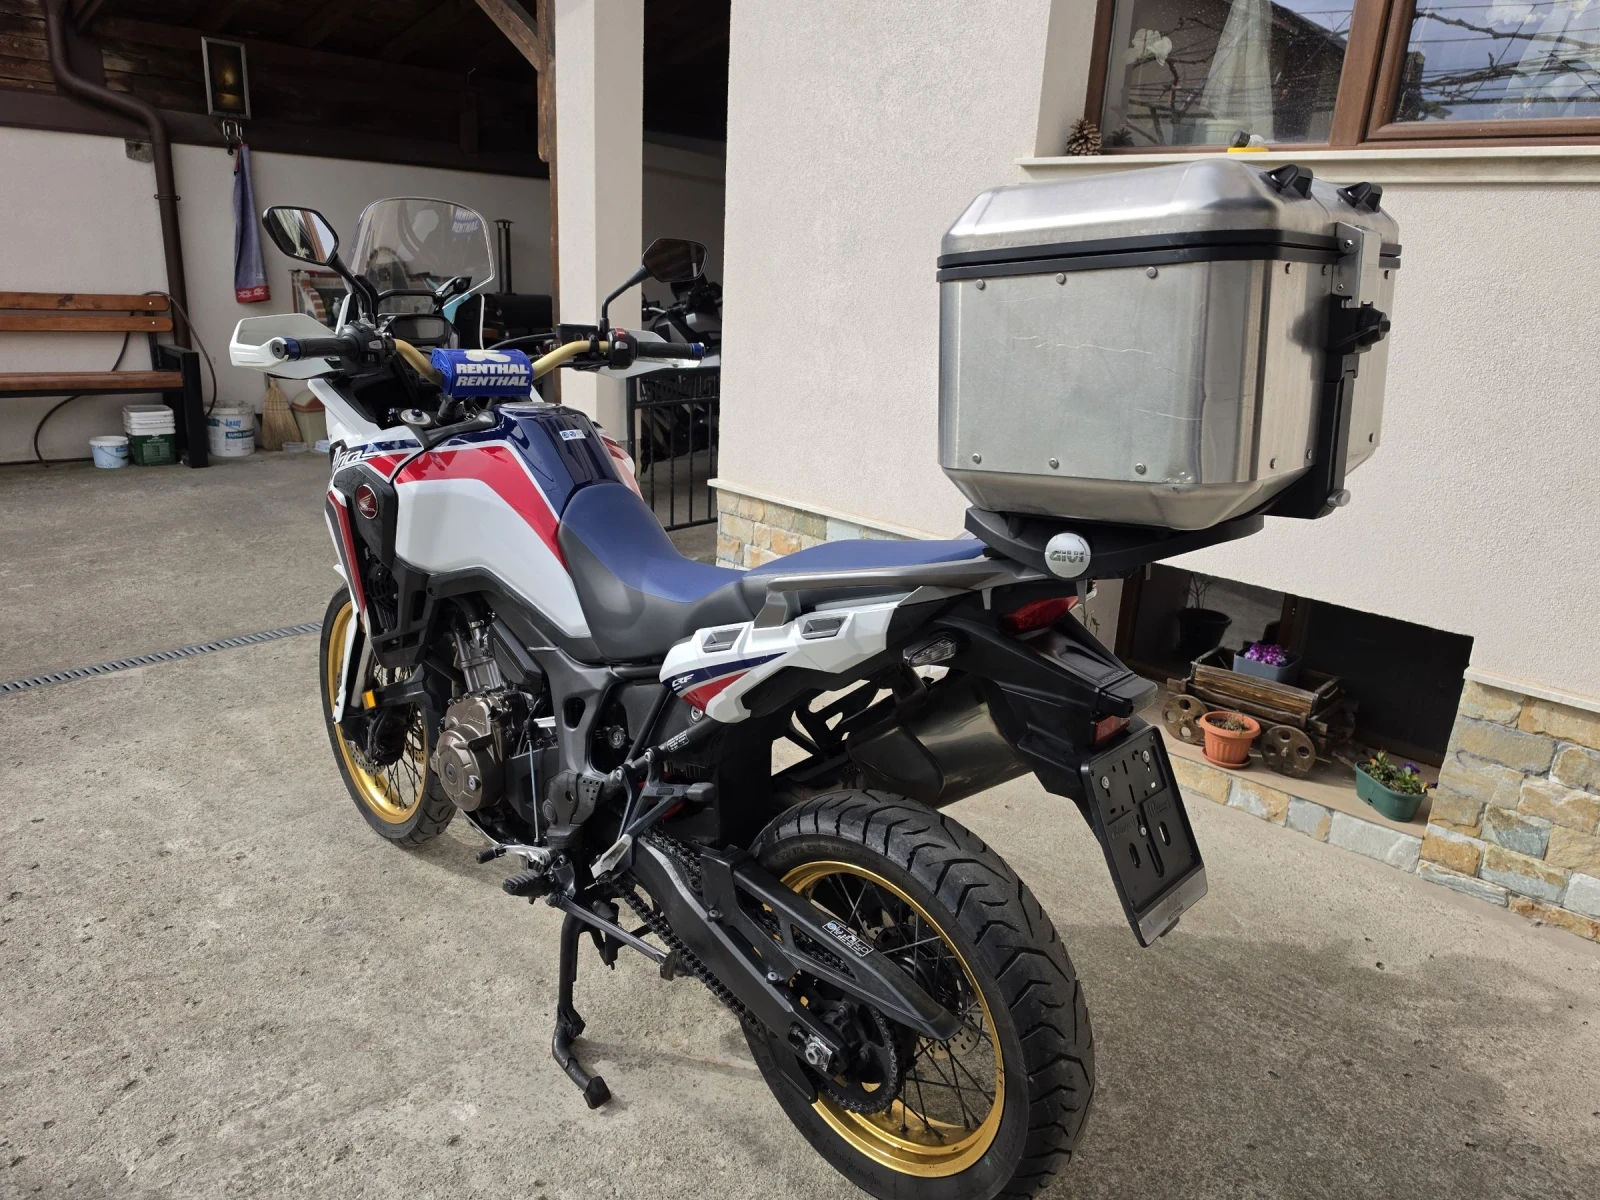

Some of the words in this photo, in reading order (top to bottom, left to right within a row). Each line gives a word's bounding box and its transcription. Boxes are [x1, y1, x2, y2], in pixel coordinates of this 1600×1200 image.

[456, 363, 530, 374] RENTHAL
[456, 376, 529, 387] RENTHAL
[1049, 550, 1085, 563] GIVI
[672, 673, 695, 687] CRF
[1100, 670, 1125, 684] HONDA
